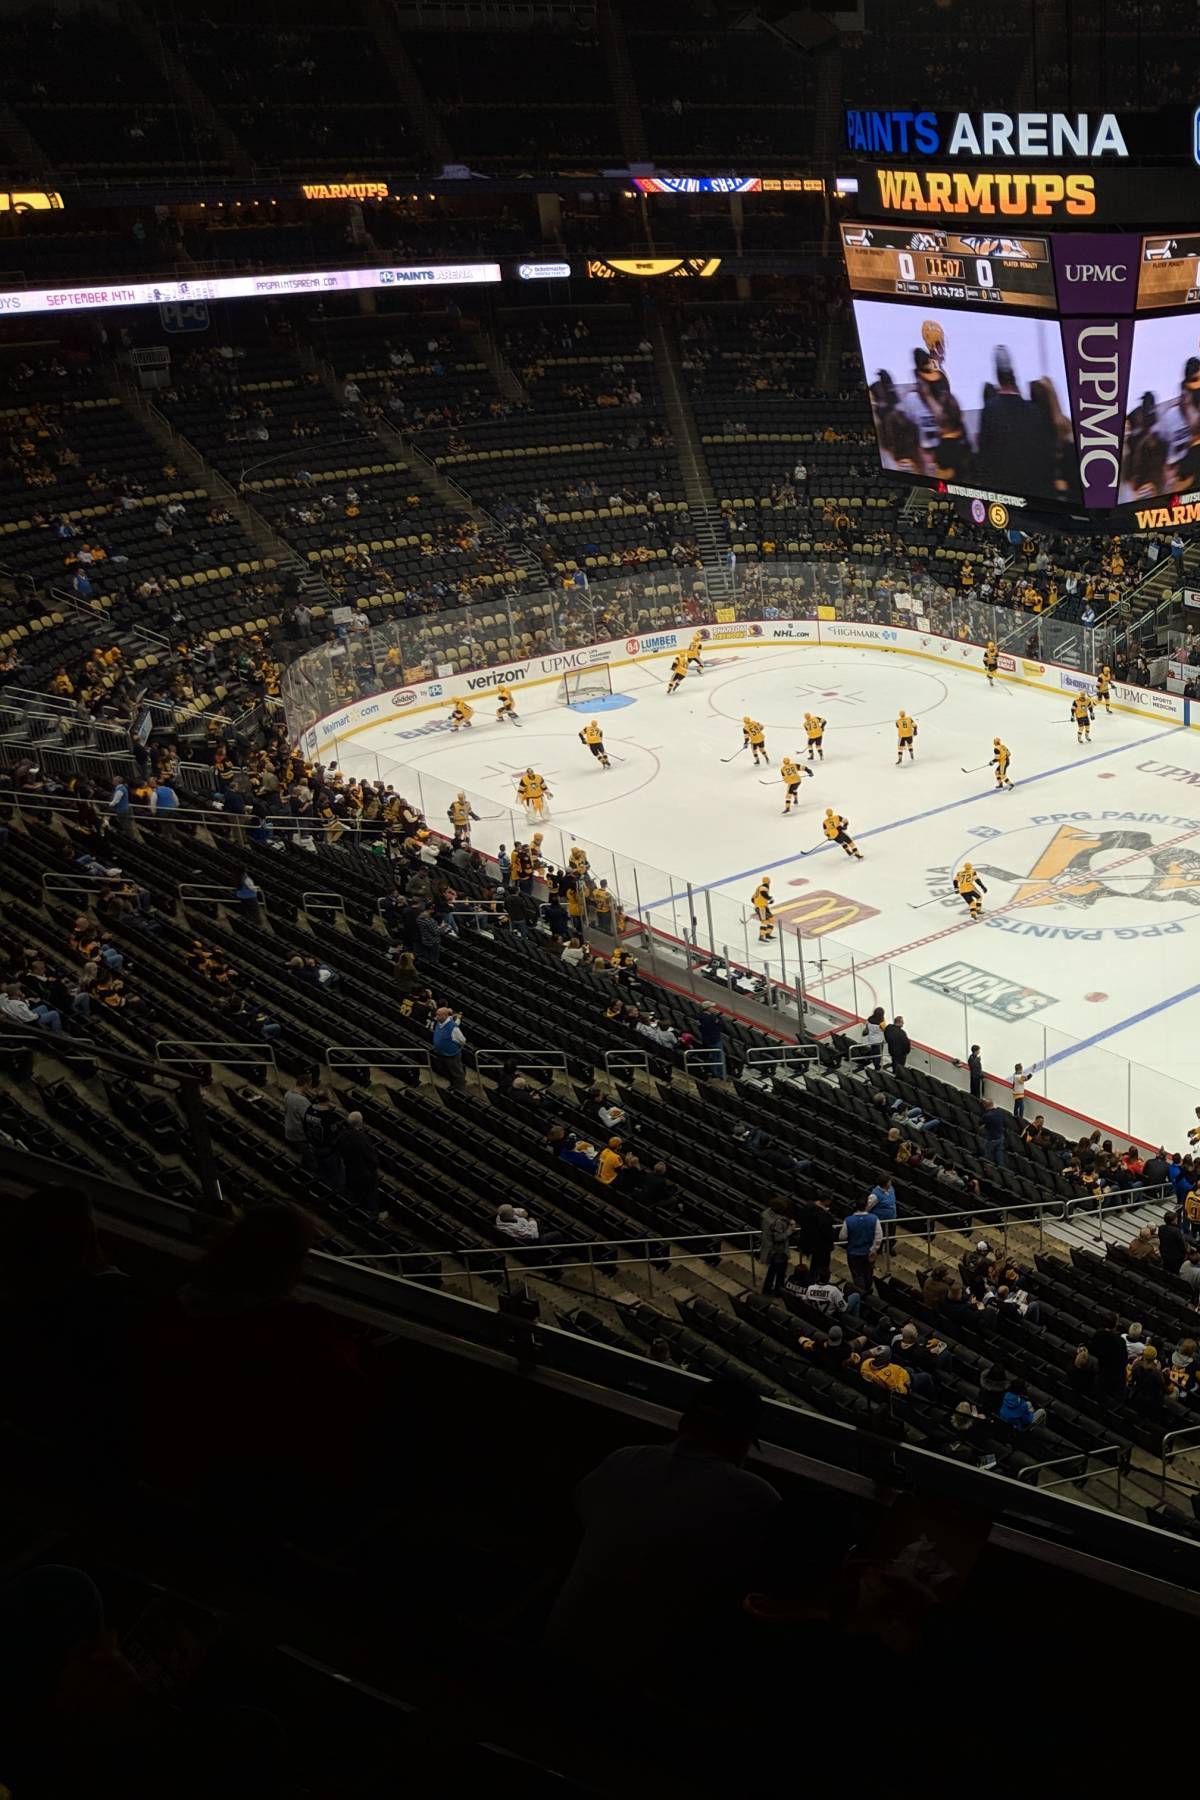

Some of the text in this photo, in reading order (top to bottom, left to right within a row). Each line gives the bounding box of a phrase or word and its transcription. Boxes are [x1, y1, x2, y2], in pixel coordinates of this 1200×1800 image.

[846, 111, 1129, 156] PAINTS ARENA
[302, 182, 388, 200] WARMUPS
[877, 169, 1096, 216] WARMUPS
[396, 271, 434, 281] PAINTS
[437, 270, 474, 280] ARENA
[898, 253, 916, 280] 0
[929, 258, 960, 277] 11:07
[976, 259, 994, 287] 0
[1064, 265, 1127, 282] UPMC
[46, 292, 108, 307] SEPTEMBER
[111, 290, 136, 302] 14TH
[932, 286, 965, 298] $13,725
[1077, 322, 1119, 488] UPMC
[946, 484, 1027, 507] MITSUBISHI ELECTRIC
[994, 512, 1002, 522] 5
[831, 625, 881, 639] HIGHMARK
[641, 634, 677, 650] LUMBER
[540, 652, 587, 673] UPMC
[466, 668, 525, 690] verizon
[392, 693, 417, 705] Glidden
[1115, 688, 1149, 705] UPMC
[1152, 696, 1173, 705] SPORTS
[322, 703, 380, 735] Walmart com
[1029, 810, 1092, 826] PPG
[960, 873, 972, 884] 72
[985, 917, 1185, 941] PPG PAINTS
[927, 963, 1049, 1014] DICK'S
